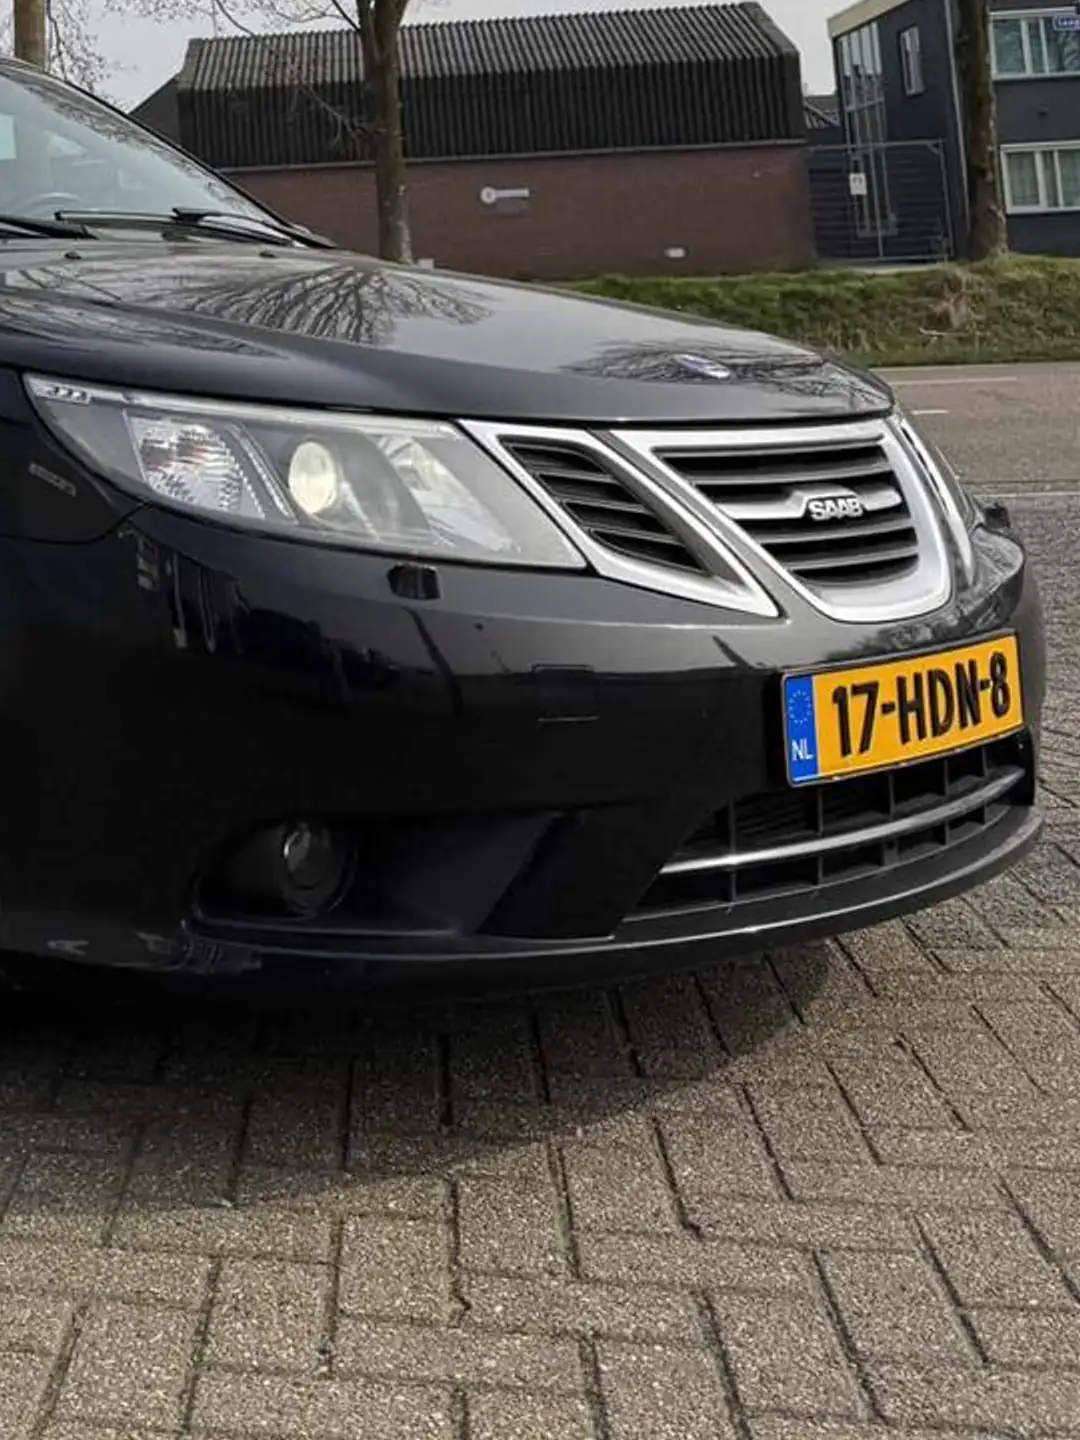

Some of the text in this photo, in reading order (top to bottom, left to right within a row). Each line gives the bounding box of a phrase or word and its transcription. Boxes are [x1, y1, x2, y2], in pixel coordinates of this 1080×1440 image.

[808, 497, 864, 521] SAAB
[791, 651, 1012, 761] NL 17-HDN-8
